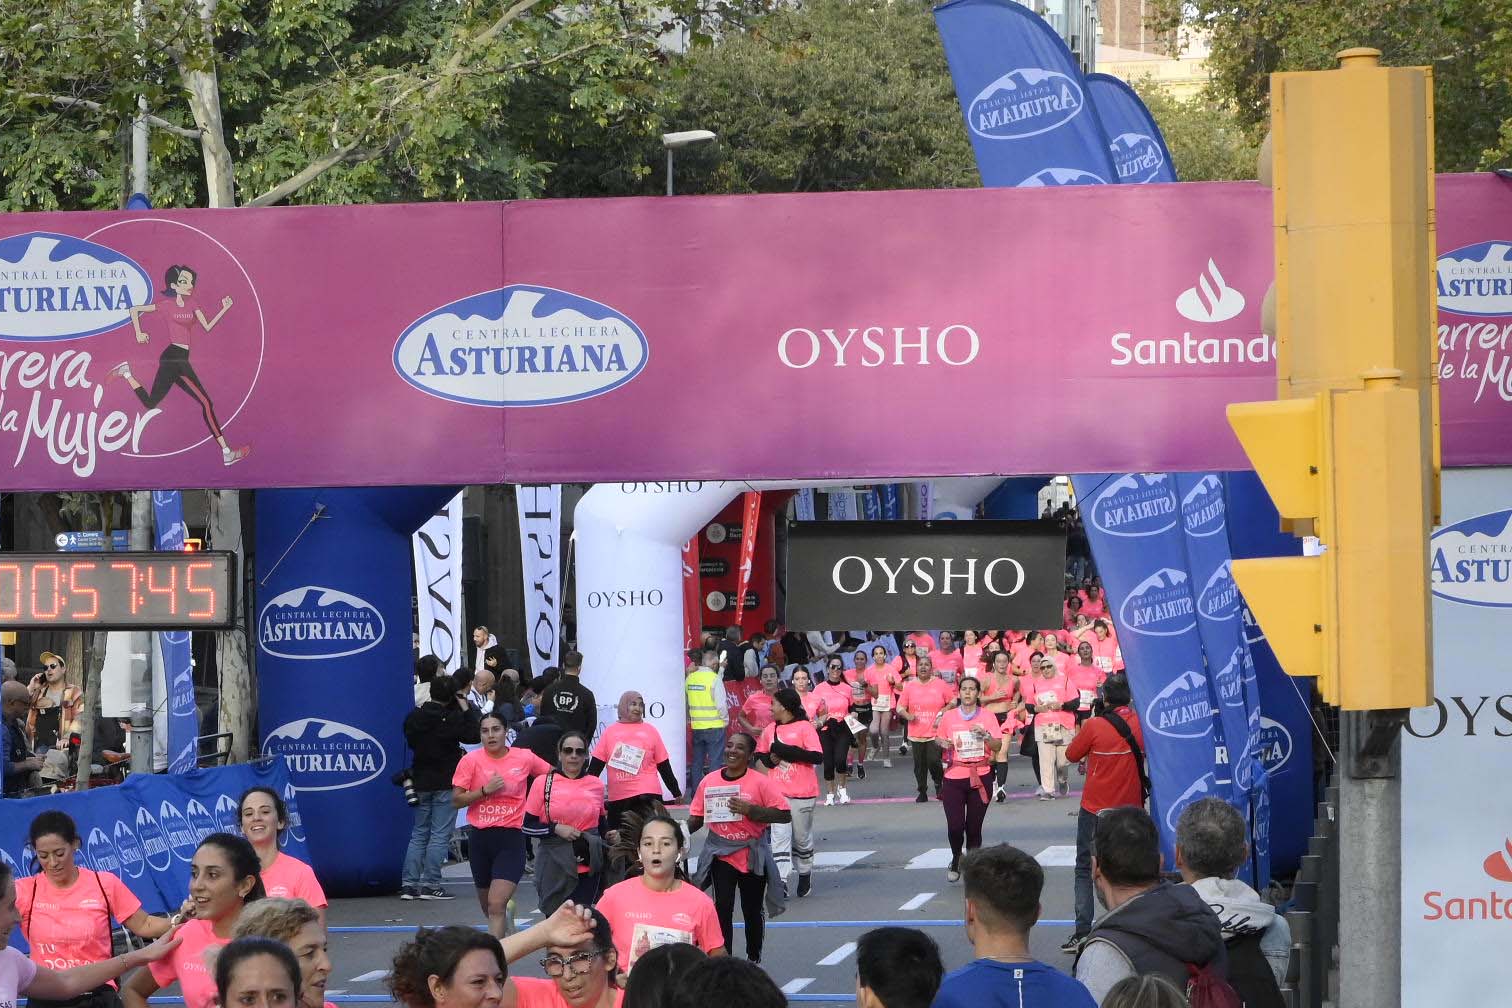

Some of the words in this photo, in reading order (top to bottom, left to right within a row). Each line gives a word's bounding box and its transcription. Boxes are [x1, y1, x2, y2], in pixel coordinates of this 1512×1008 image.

[56, 269, 127, 279] LECHERA
[453, 327, 531, 339] CENTRAL
[540, 326, 619, 337] LECHERA
[777, 325, 979, 368] OYSHO
[1437, 322, 1512, 350] arrer
[413, 332, 627, 376] ASTURIANA
[1110, 332, 1277, 366] Santand
[1460, 351, 1479, 379] la
[14, 384, 162, 477] Mujer
[831, 555, 1026, 597] OYSHO
[587, 589, 663, 608] OYSHO
[275, 611, 319, 619] CENTRAL
[322, 611, 371, 619] LECHERA
[262, 617, 376, 644] ASTURIANA
[559, 696, 572, 705] BP
[1403, 696, 1512, 740] OYS
[277, 744, 319, 752] CENTRAL
[324, 743, 371, 751] LECHERA
[284, 754, 376, 773] TURIANA
[1423, 891, 1512, 920] Santa
